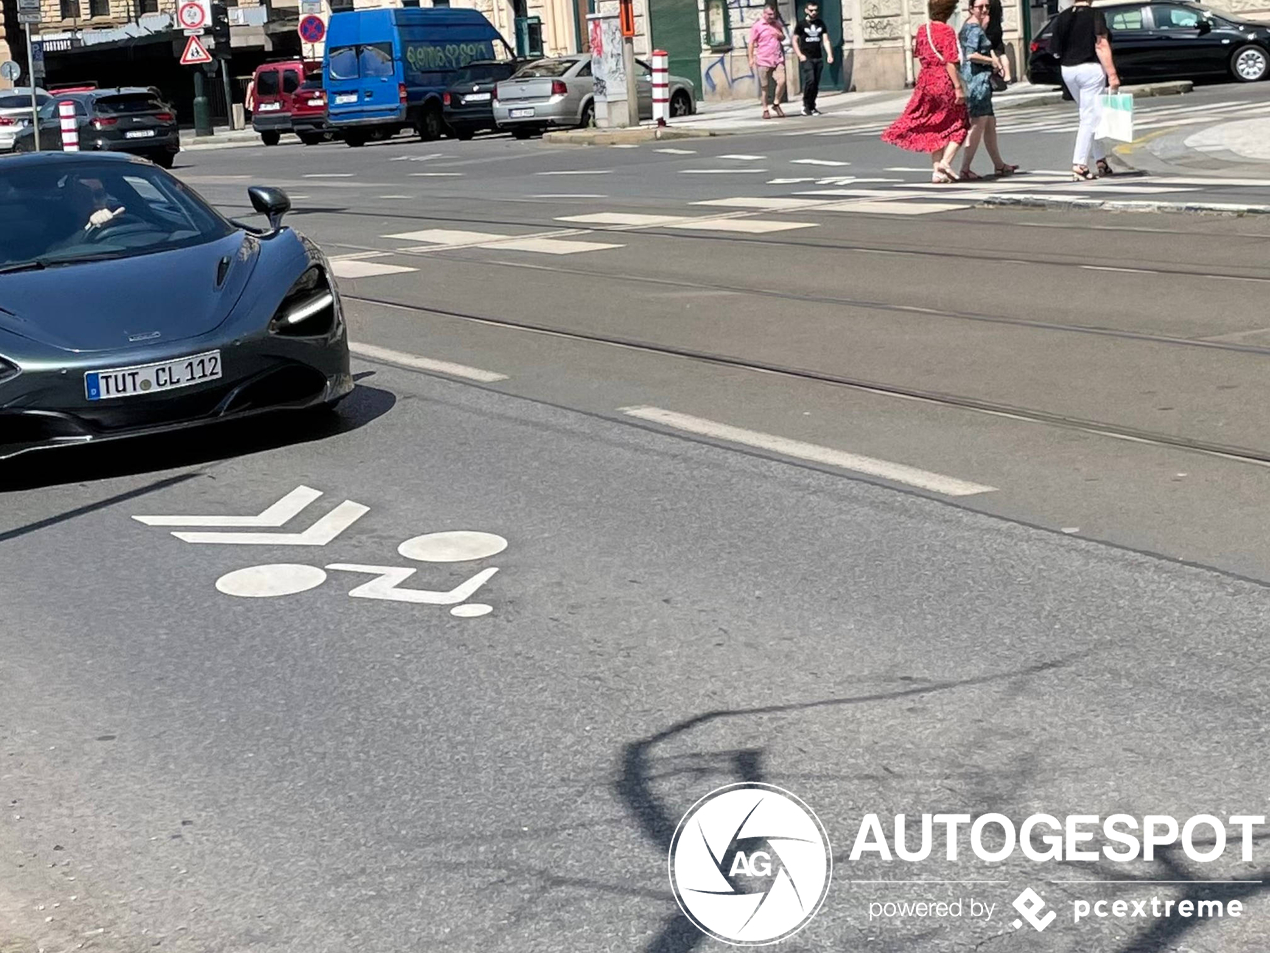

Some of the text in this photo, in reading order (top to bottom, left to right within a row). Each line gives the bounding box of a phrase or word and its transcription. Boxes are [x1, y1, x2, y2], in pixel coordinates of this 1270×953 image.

[101, 356, 219, 395] TUT CL 112
